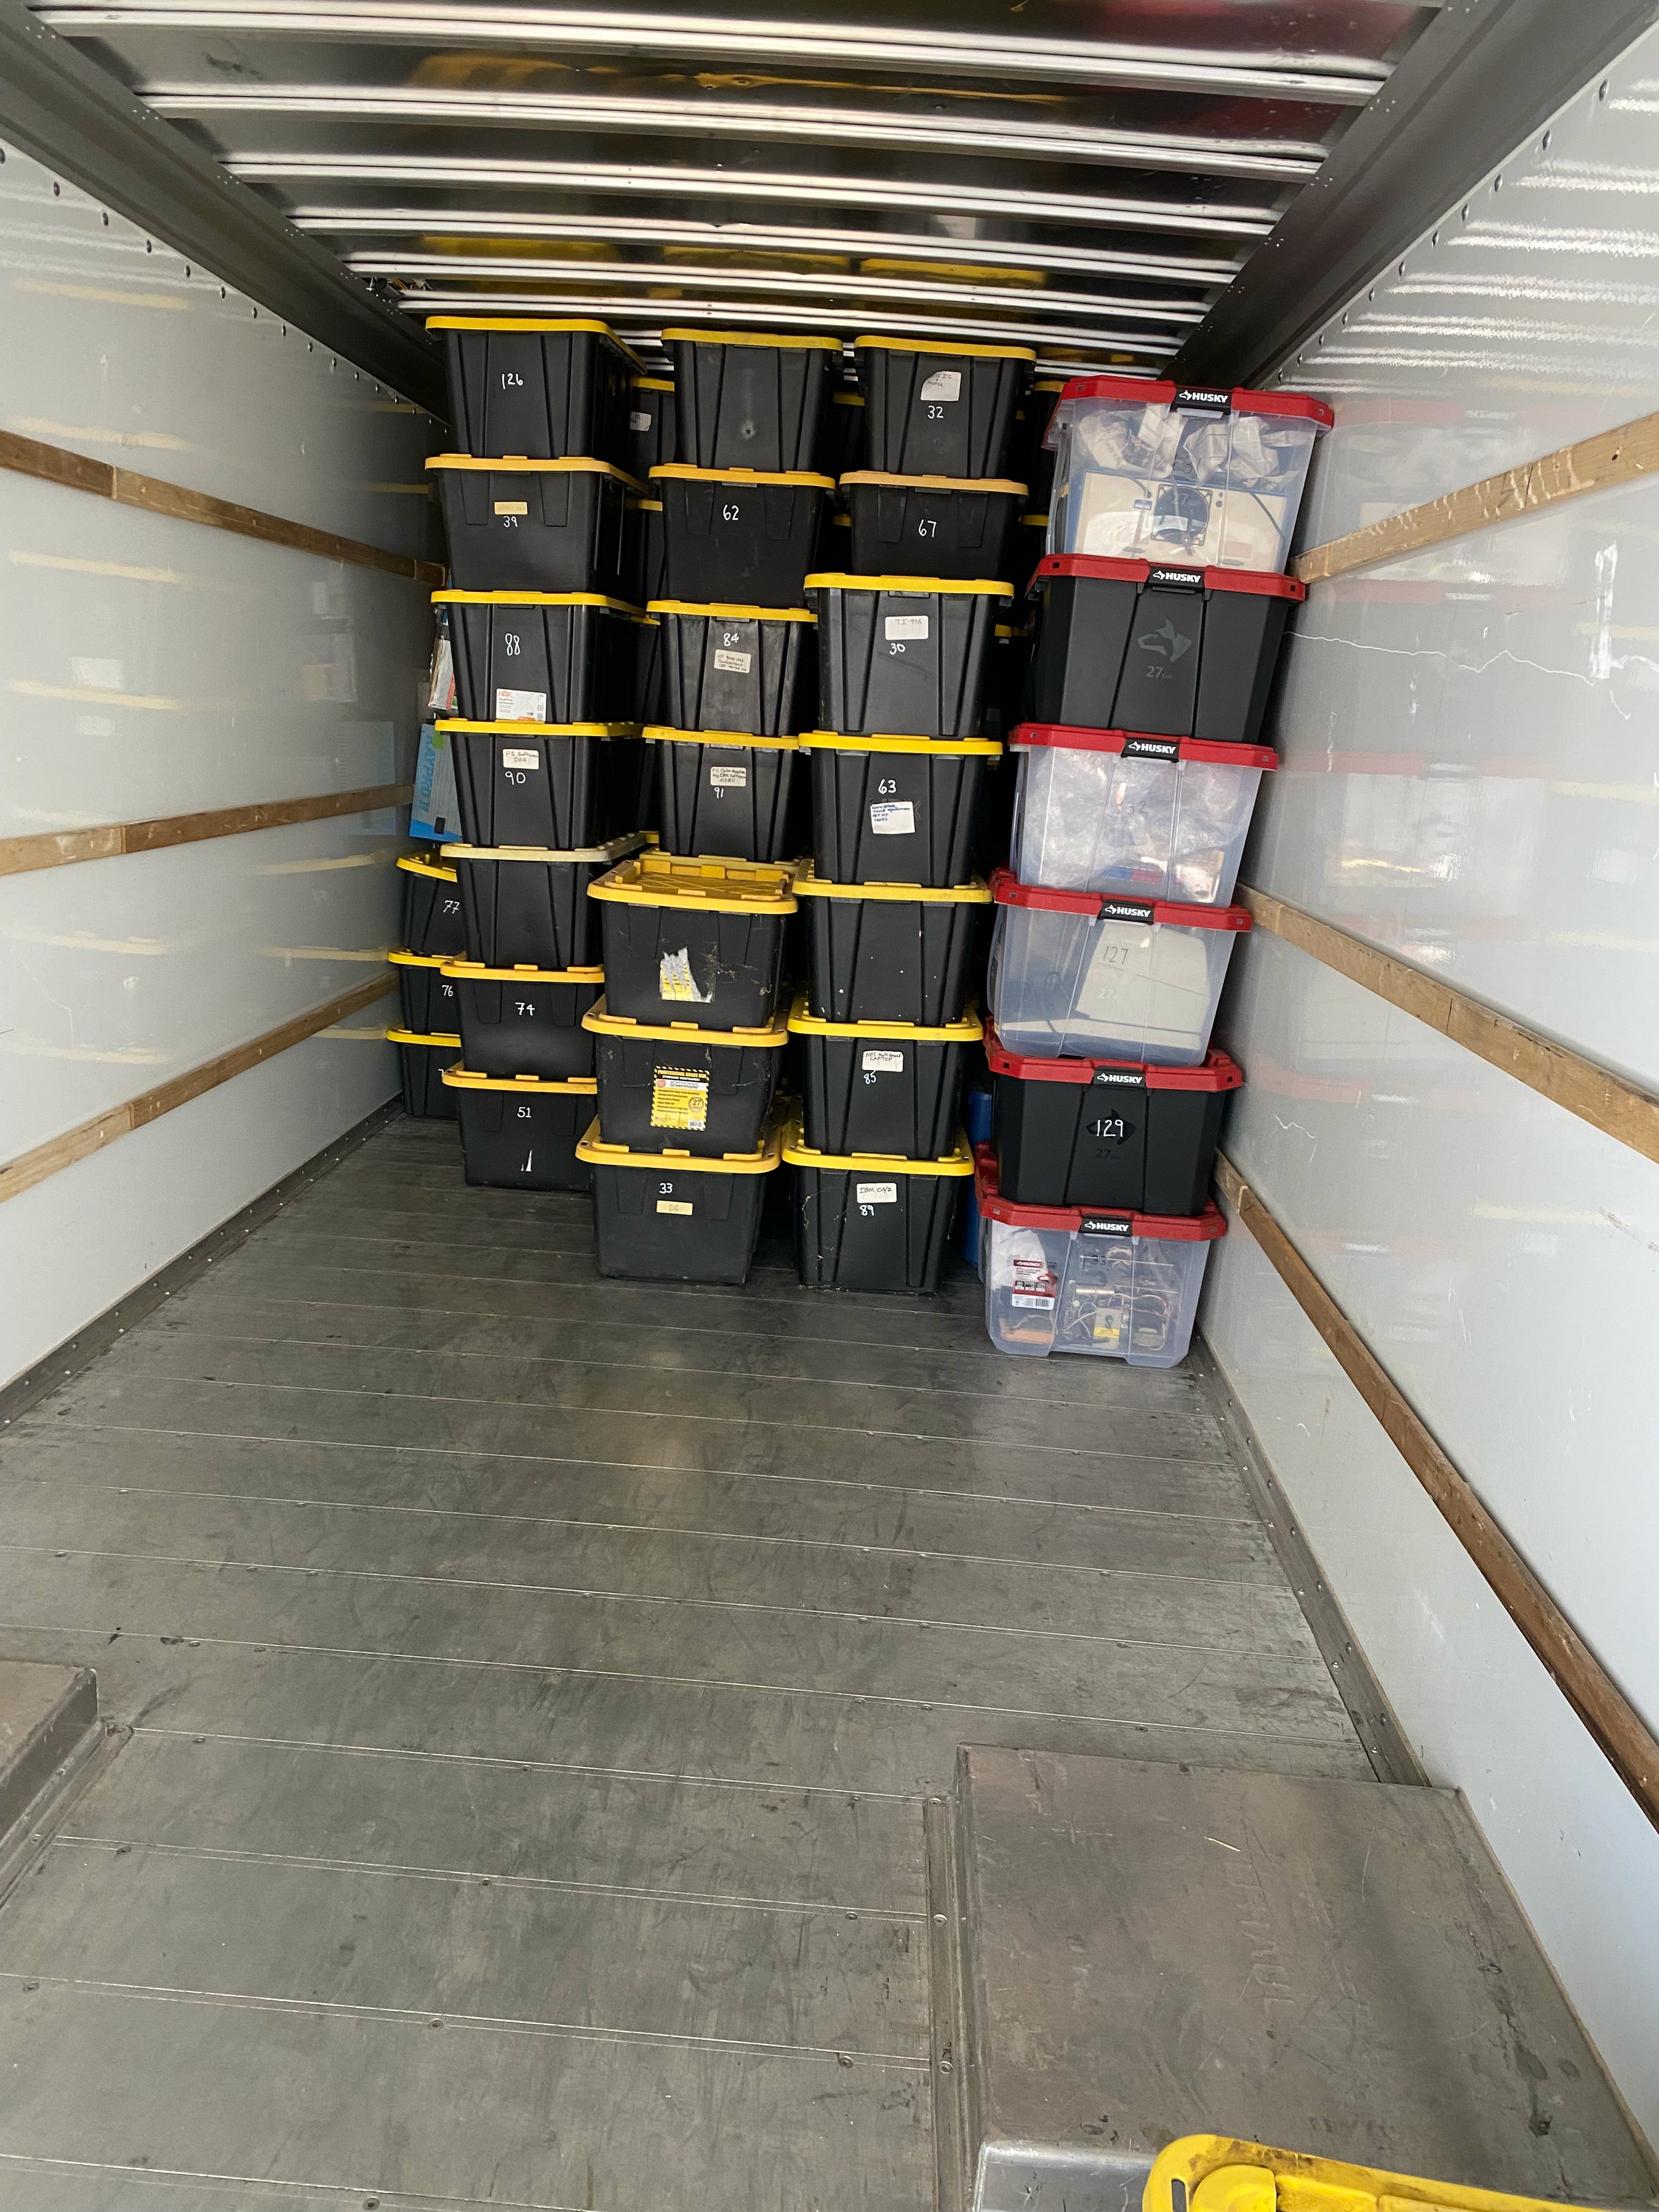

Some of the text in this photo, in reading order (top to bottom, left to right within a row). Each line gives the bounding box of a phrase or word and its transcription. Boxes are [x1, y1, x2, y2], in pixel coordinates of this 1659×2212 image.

[501, 374, 523, 390] 126
[1192, 392, 1228, 403] HUSKY
[927, 405, 944, 419] 32
[723, 504, 739, 521] 62
[503, 516, 518, 528] 39
[918, 518, 937, 537] 67
[1165, 572, 1201, 584] HUSKY
[505, 633, 521, 656] 88
[724, 633, 740, 646] 84
[889, 643, 906, 655] 30
[1147, 665, 1163, 678] 27
[1141, 744, 1176, 754] HUSKY
[505, 771, 526, 785] 90
[878, 778, 896, 794] 63
[714, 787, 724, 799] 91
[443, 900, 460, 914] 77
[1117, 907, 1152, 917] HUSKY
[1103, 945, 1128, 965] 127
[442, 985, 453, 997] 76
[515, 1002, 535, 1016] 74
[863, 1070, 877, 1085] 85
[1109, 1075, 1143, 1084] HUSKY
[517, 1107, 532, 1118] 51
[1097, 1119, 1124, 1137] 129
[1097, 1149, 1111, 1158] 27
[659, 1183, 673, 1194] 33
[860, 1205, 874, 1216] 89
[1096, 1222, 1130, 1232] HUSKY
